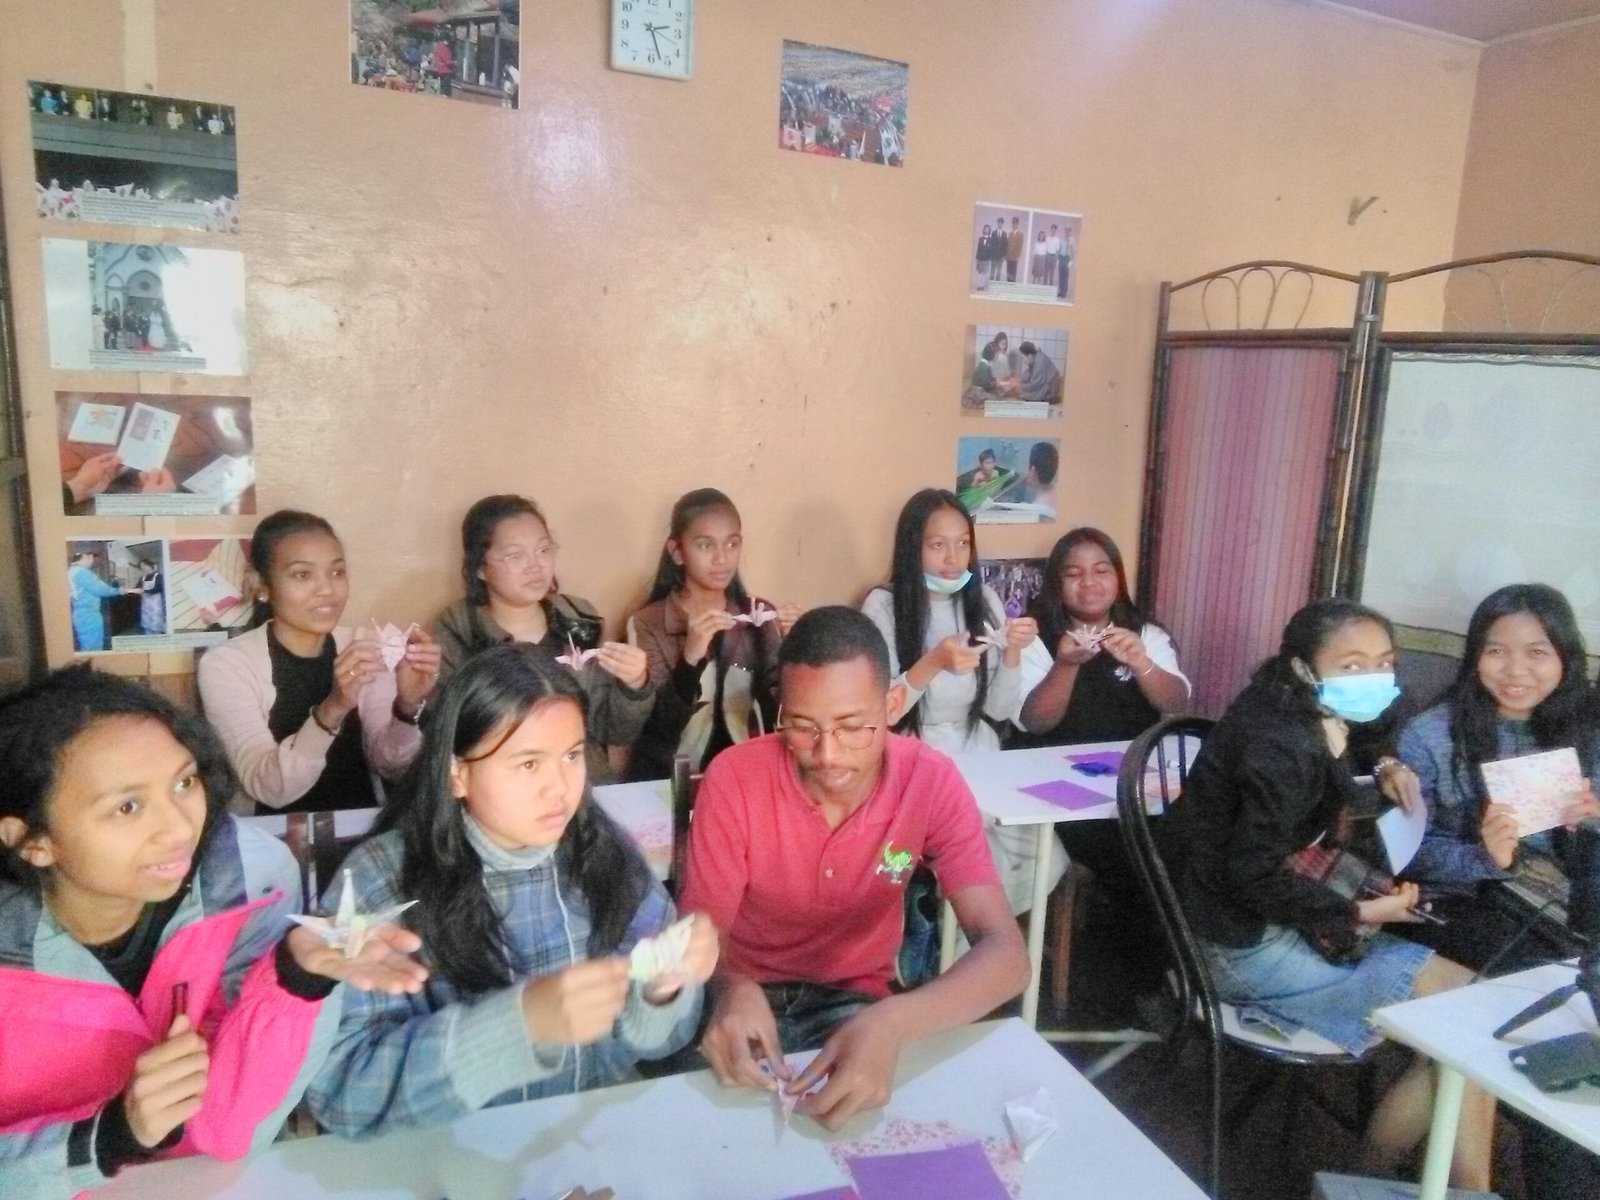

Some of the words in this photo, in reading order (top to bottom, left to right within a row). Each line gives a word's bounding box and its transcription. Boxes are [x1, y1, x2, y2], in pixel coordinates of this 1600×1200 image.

[622, 1, 632, 12] 10
[675, 11, 682, 22] 2
[621, 19, 629, 30] 9
[675, 29, 682, 39] 3
[621, 39, 629, 49] 8
[632, 49, 639, 61] 7
[647, 53, 655, 64] 6
[674, 49, 680, 59] 4
[664, 55, 671, 66] 5
